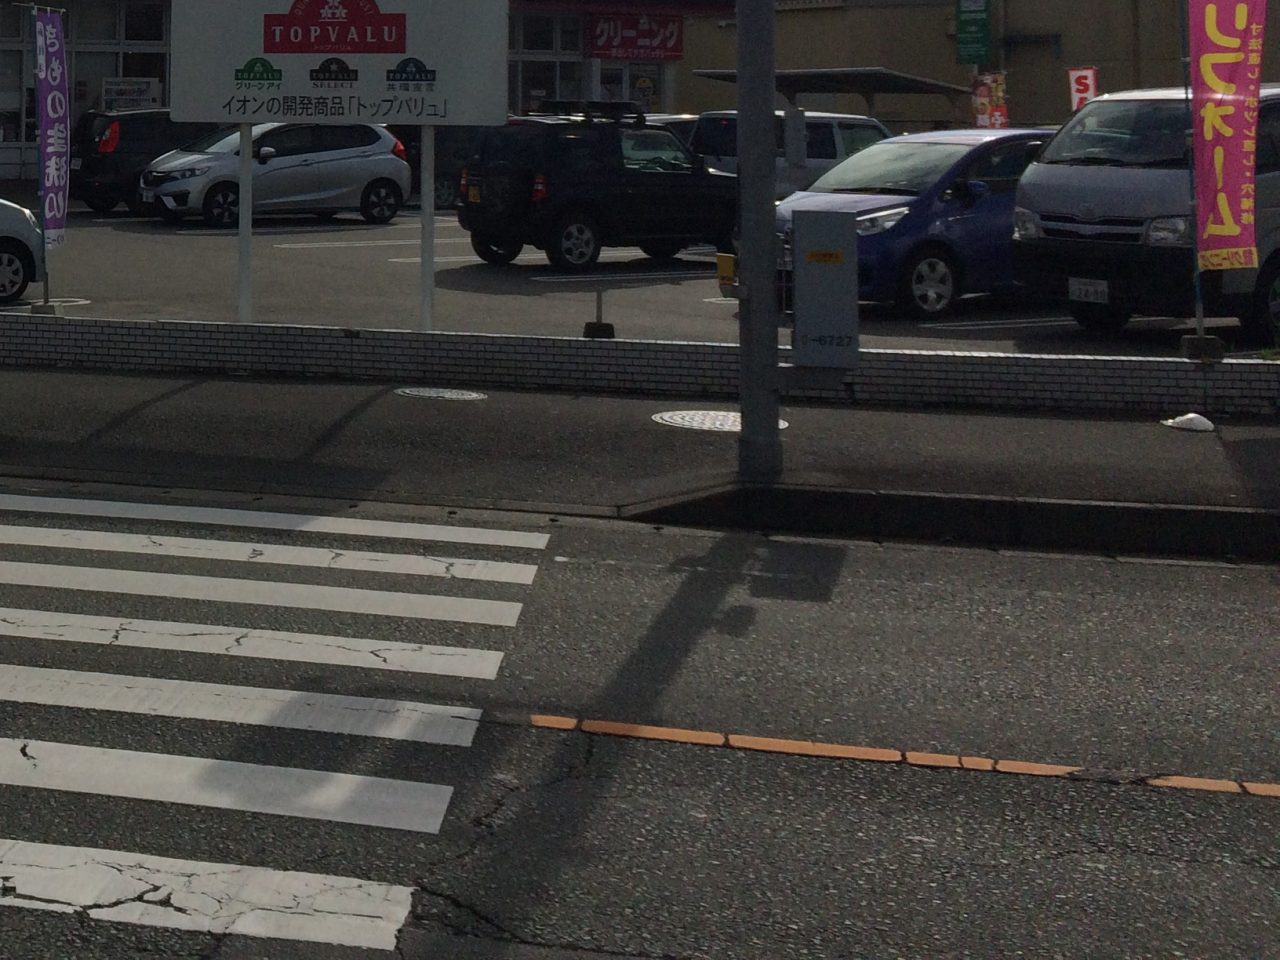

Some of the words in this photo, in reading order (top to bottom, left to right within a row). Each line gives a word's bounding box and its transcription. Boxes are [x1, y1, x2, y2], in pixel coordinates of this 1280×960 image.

[272, 26, 396, 42] TOPVALU
[594, 15, 680, 48] クリーニング
[312, 81, 354, 89] SELECT
[222, 95, 448, 118] イオンの開発商品「トップバリュ」
